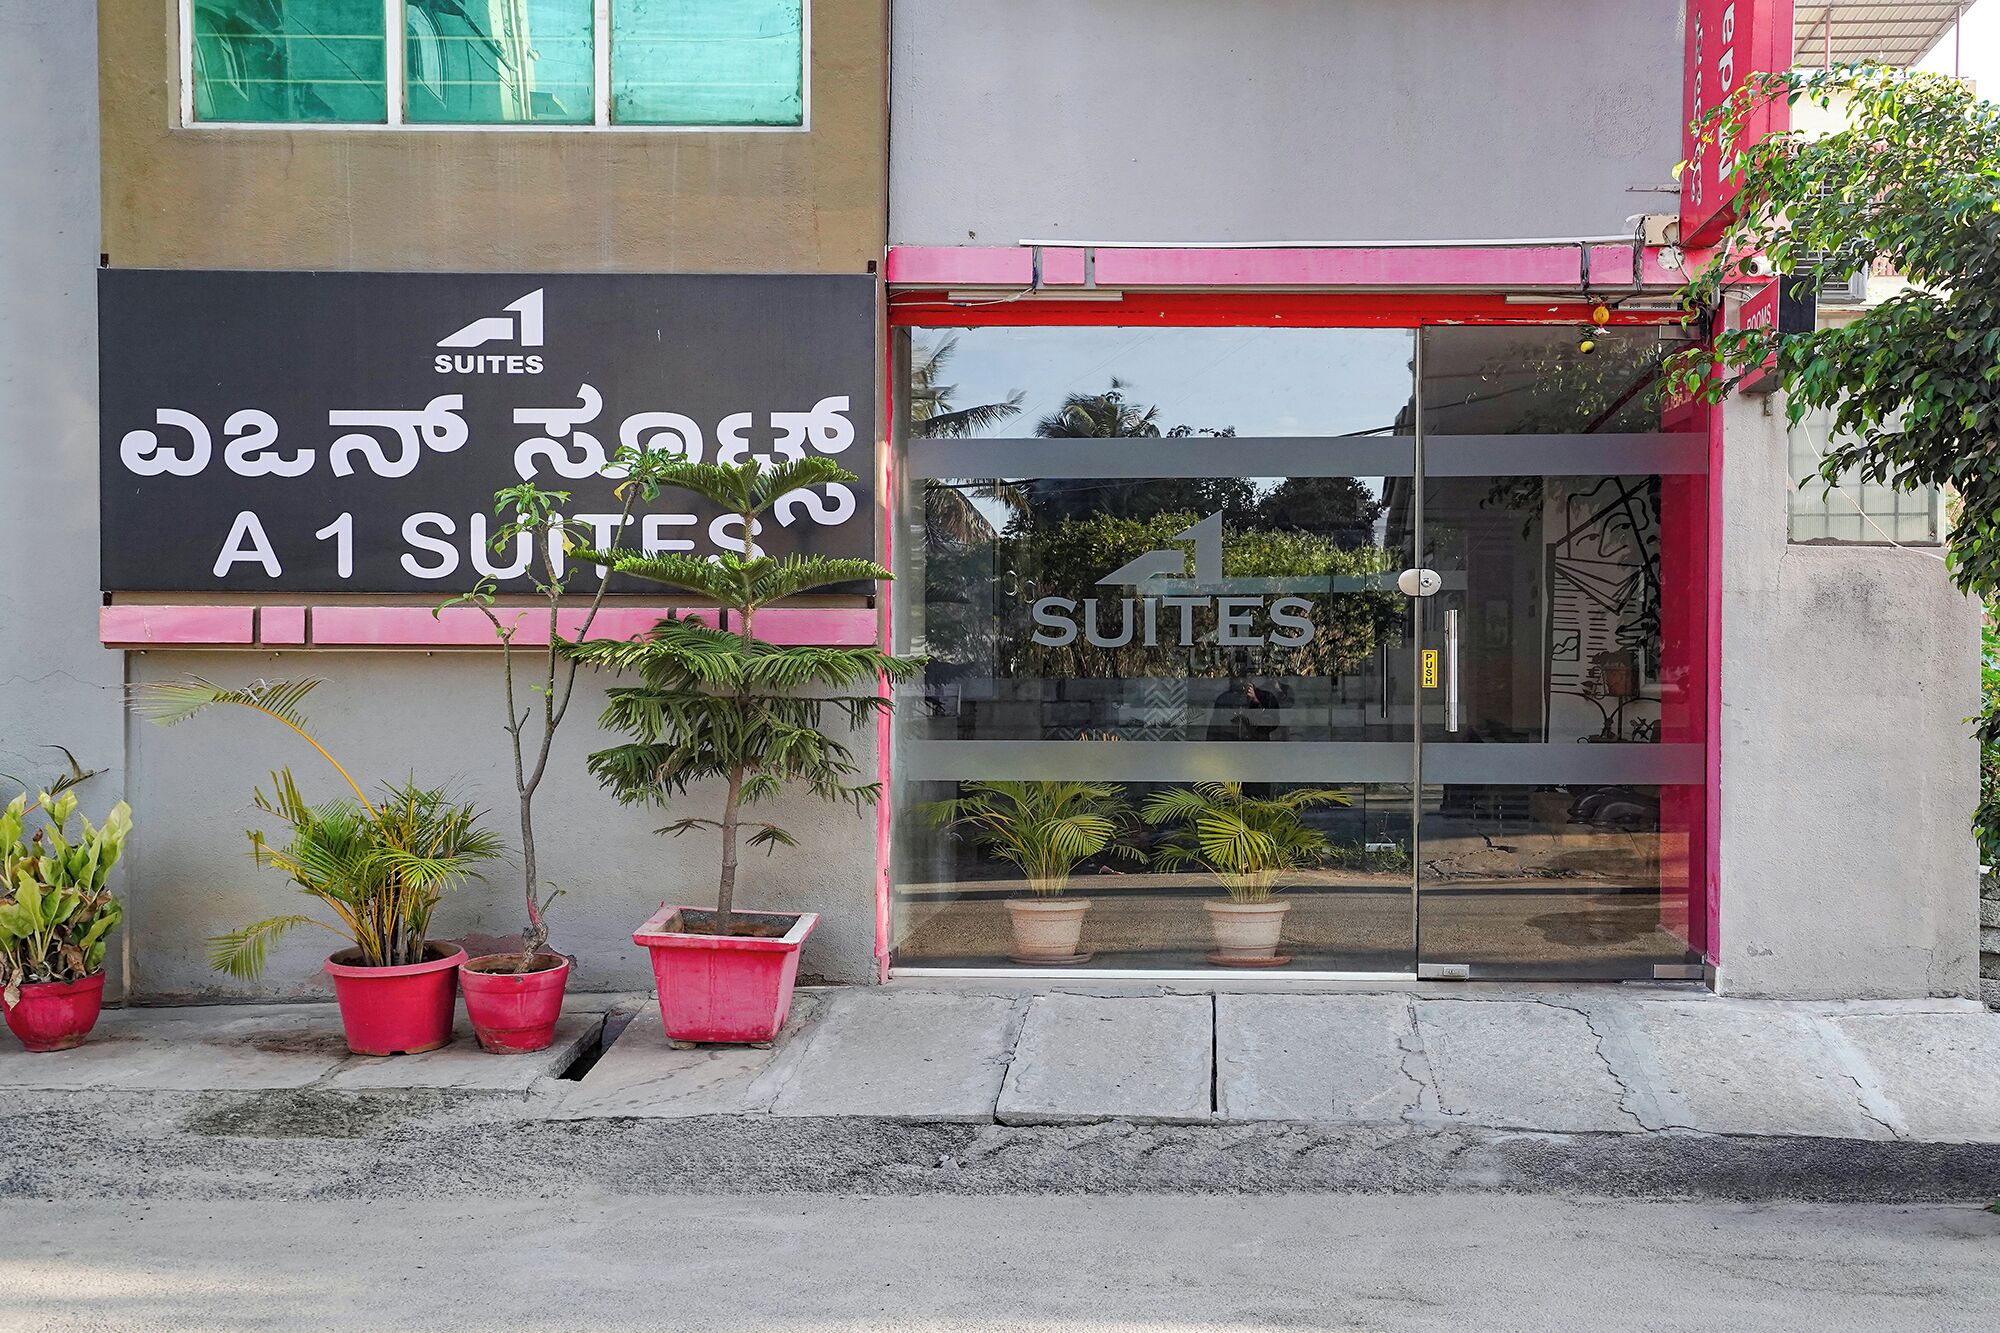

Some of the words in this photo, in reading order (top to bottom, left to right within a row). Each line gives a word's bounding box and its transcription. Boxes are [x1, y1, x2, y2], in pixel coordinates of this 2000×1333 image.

[434, 354, 544, 374] SUITES
[212, 510, 283, 578] A
[314, 511, 353, 579] 1
[1031, 596, 1316, 648] SUITES
[1425, 653, 1433, 685] PUSH
